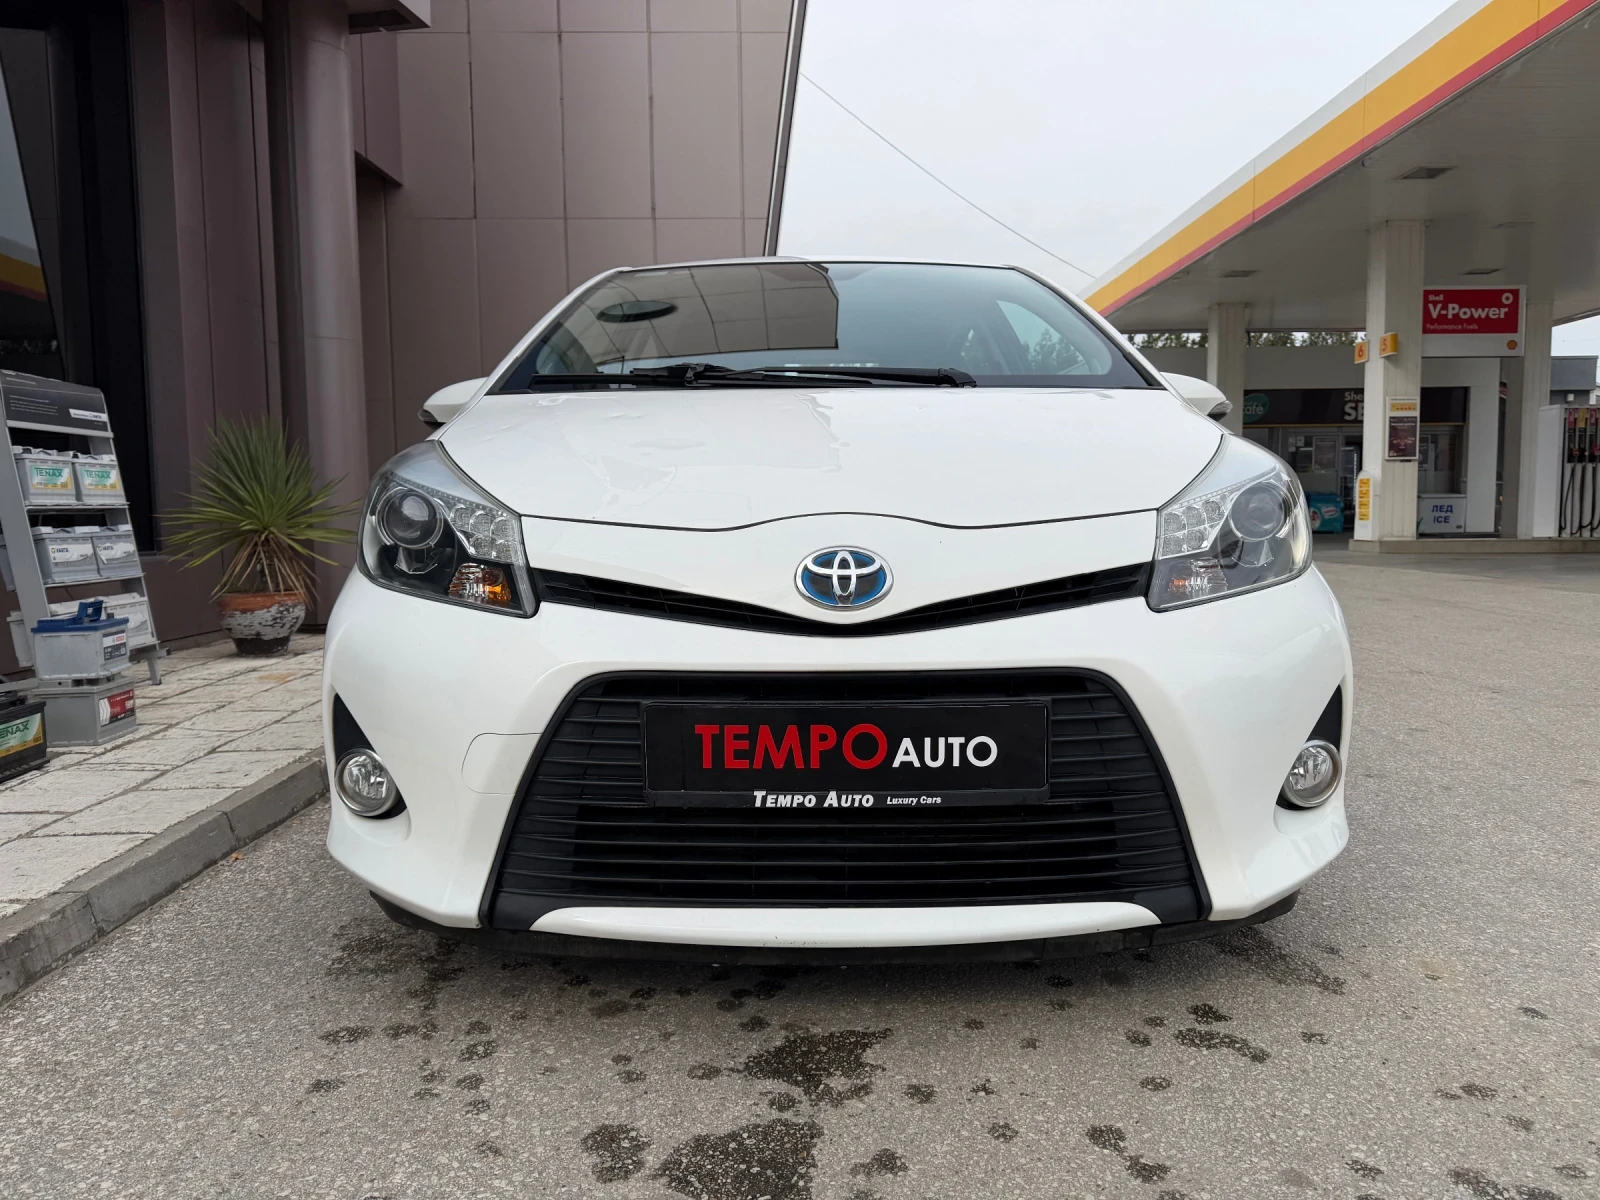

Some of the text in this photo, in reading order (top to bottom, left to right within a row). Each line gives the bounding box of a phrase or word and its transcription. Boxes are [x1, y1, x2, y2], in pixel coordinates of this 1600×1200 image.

[1428, 303, 1509, 319] V-Power
[1381, 338, 1388, 351] 5
[1357, 344, 1365, 358] 6
[1344, 390, 1364, 401] She
[1243, 402, 1264, 415] afé
[34, 467, 64, 478] TENAX
[84, 470, 112, 480] TENAX
[1431, 504, 1454, 514] ЛЕД
[1433, 515, 1451, 524] ICE
[0, 720, 30, 739] ENAX
[694, 723, 998, 770] TEMPO AUTO
[886, 796, 918, 806] Luxury
[920, 796, 942, 805] Cars
